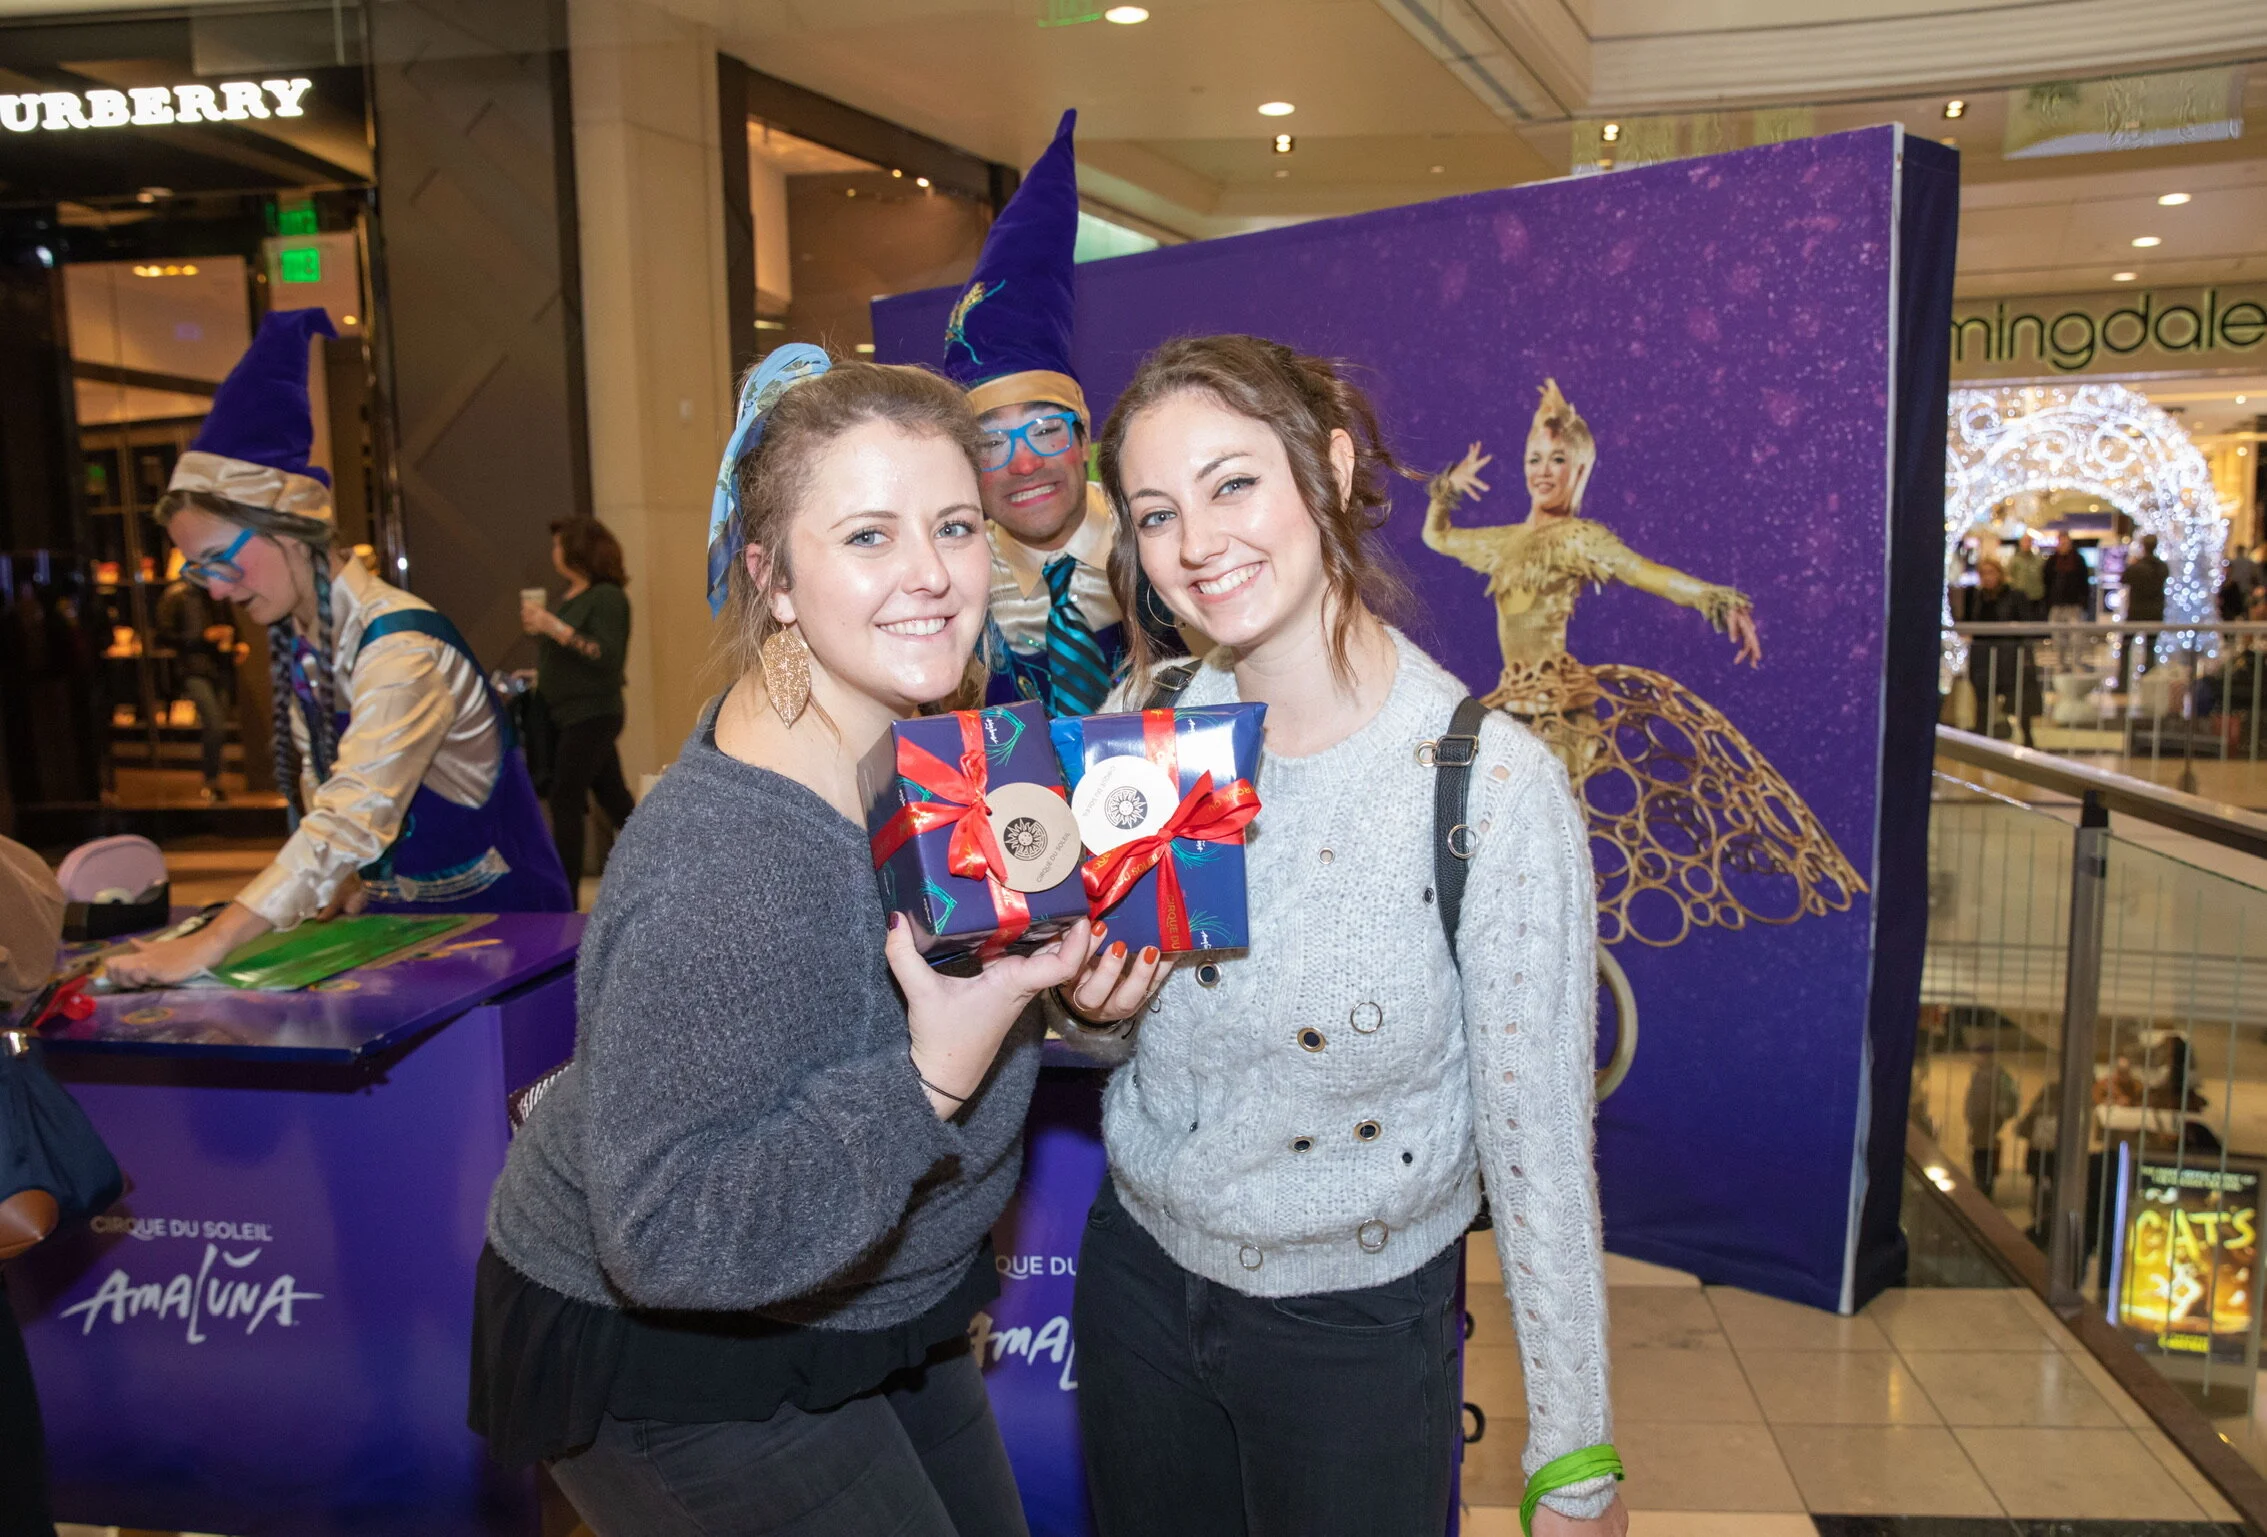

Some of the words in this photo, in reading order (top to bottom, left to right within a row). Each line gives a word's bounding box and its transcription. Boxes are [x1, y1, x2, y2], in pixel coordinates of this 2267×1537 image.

[0, 78, 312, 132] URBERRY
[90, 1216, 168, 1241] CIRQUE
[169, 1219, 199, 1238] DU
[202, 1221, 273, 1242] SOLEIL
